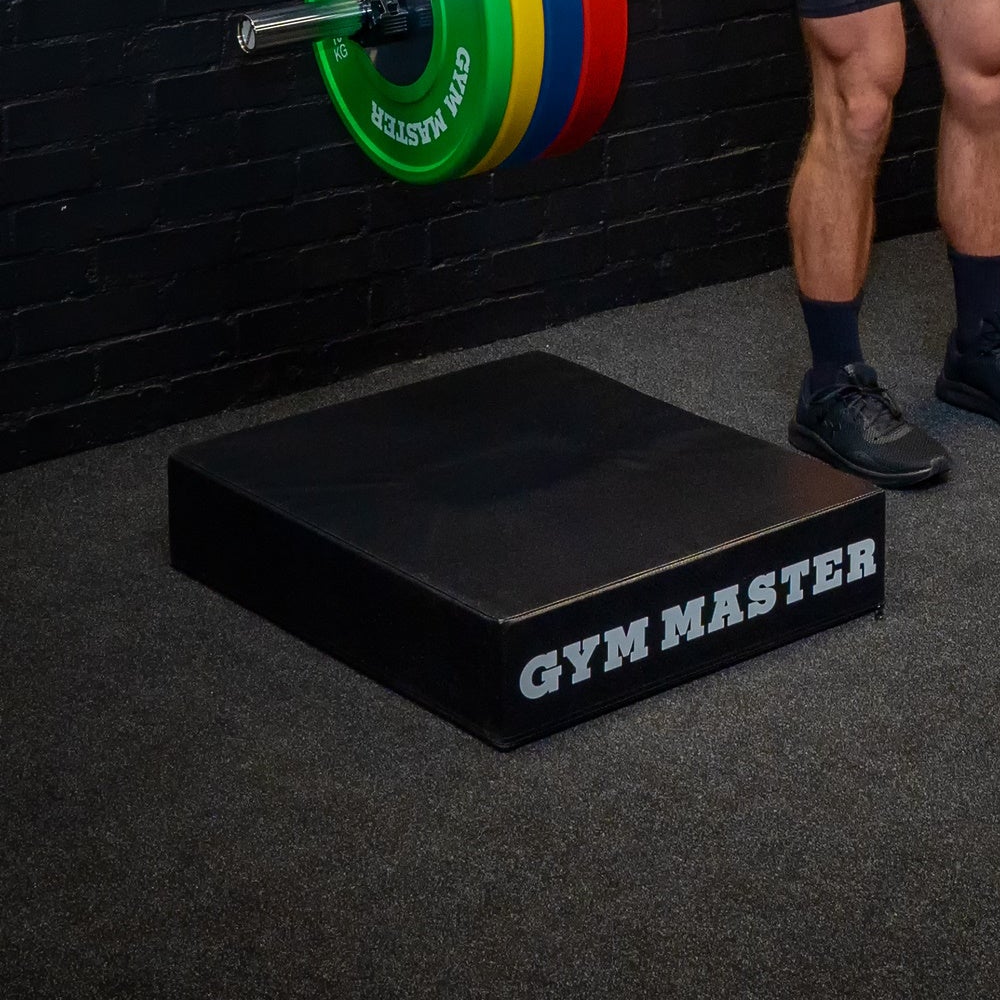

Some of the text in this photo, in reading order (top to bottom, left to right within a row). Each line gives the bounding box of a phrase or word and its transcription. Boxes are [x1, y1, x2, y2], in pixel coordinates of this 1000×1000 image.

[333, 43, 348, 62] KG
[371, 47, 471, 146] GYM MASTER
[519, 538, 877, 700] GYM MASTER
